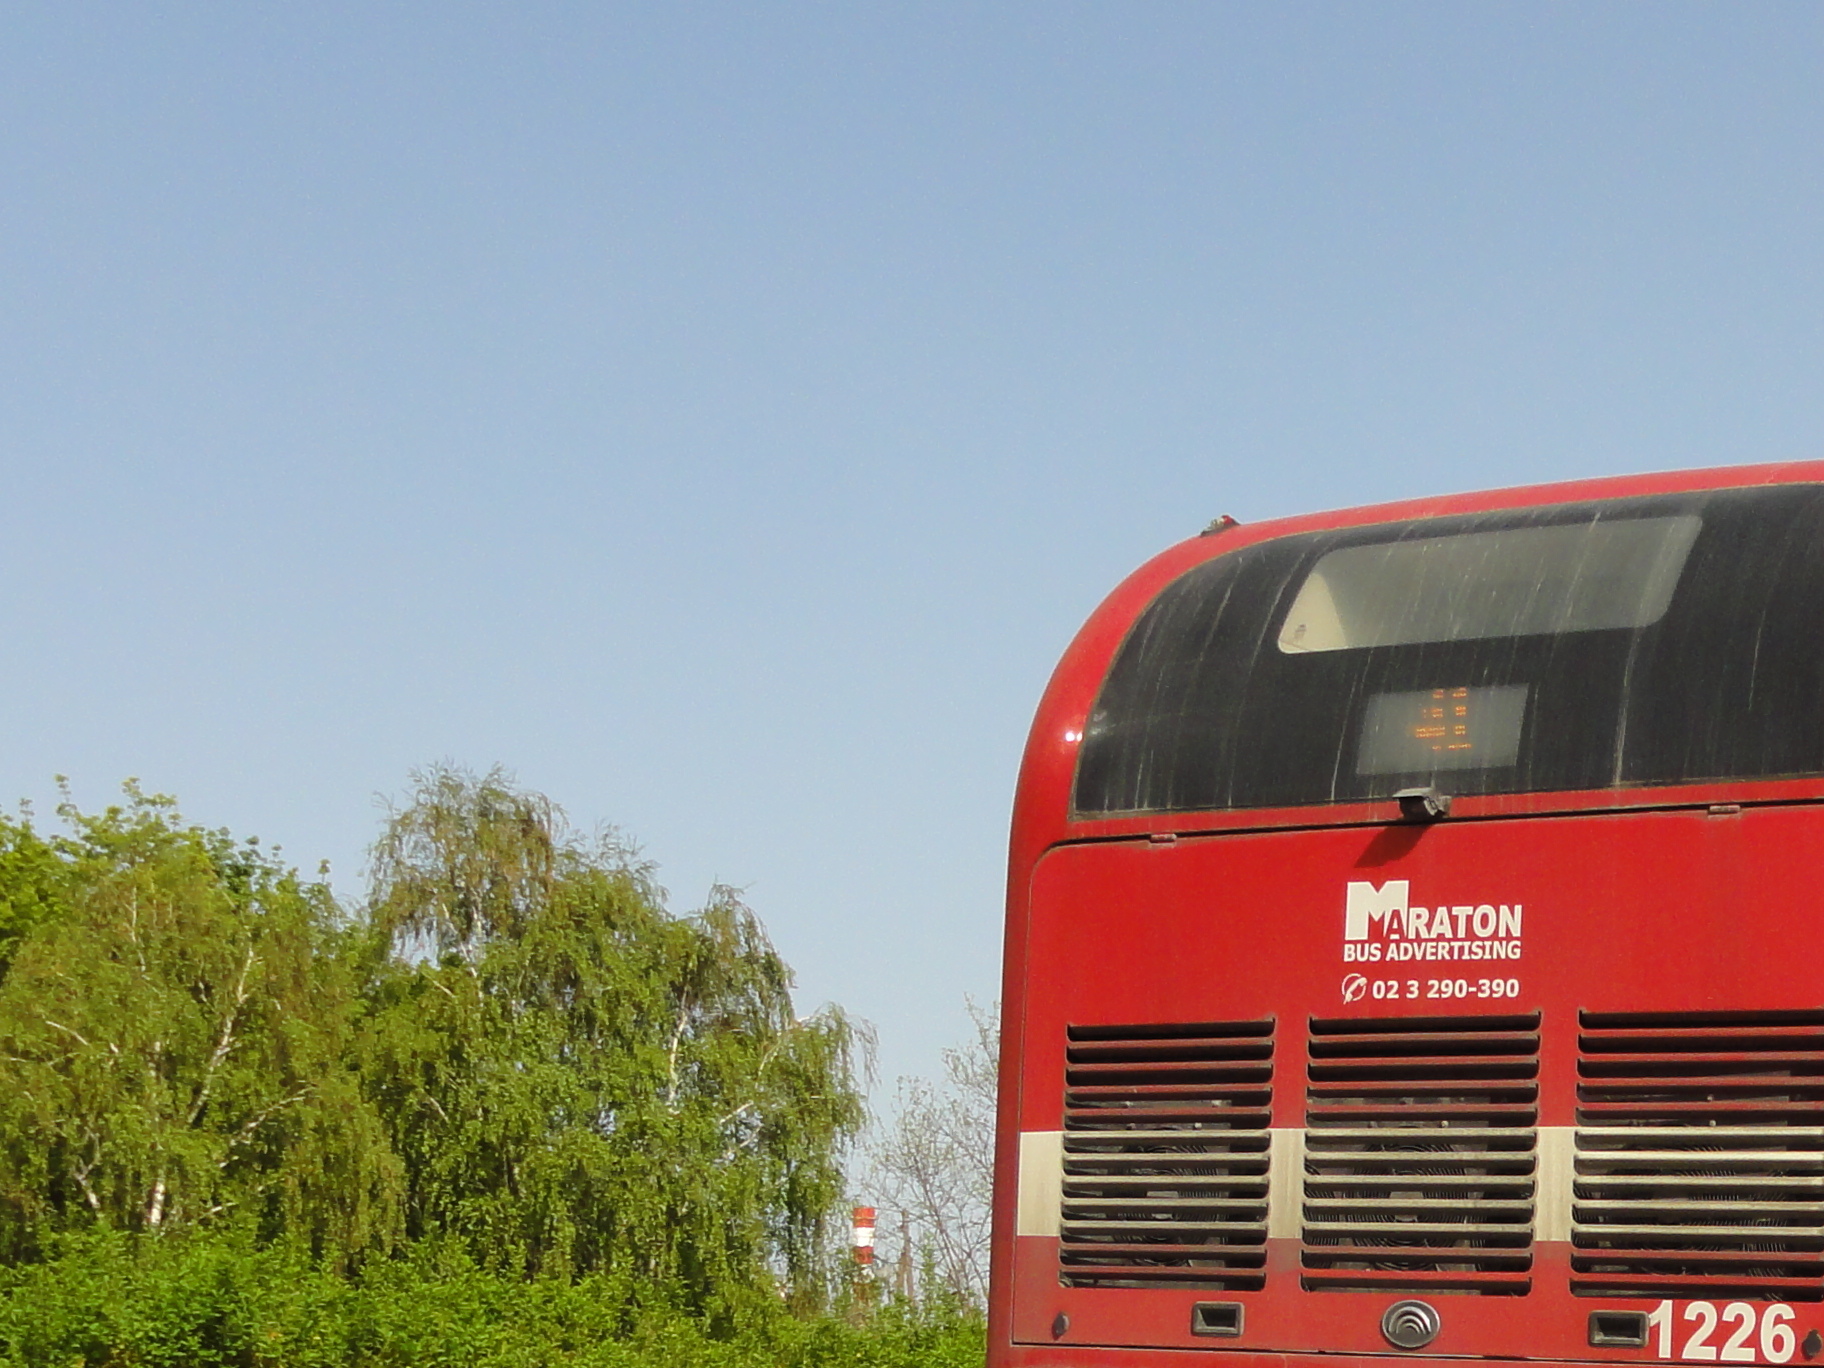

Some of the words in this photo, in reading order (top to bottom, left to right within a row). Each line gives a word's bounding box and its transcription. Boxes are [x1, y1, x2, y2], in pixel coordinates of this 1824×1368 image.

[1345, 880, 1522, 940] MARATON
[1343, 943, 1382, 962] BUS
[1385, 940, 1522, 962] ADVERTISING
[1372, 980, 1400, 999] 02
[1405, 980, 1420, 999] 3
[1427, 979, 1520, 999] 290-390
[1648, 1299, 1797, 1364] 1226
